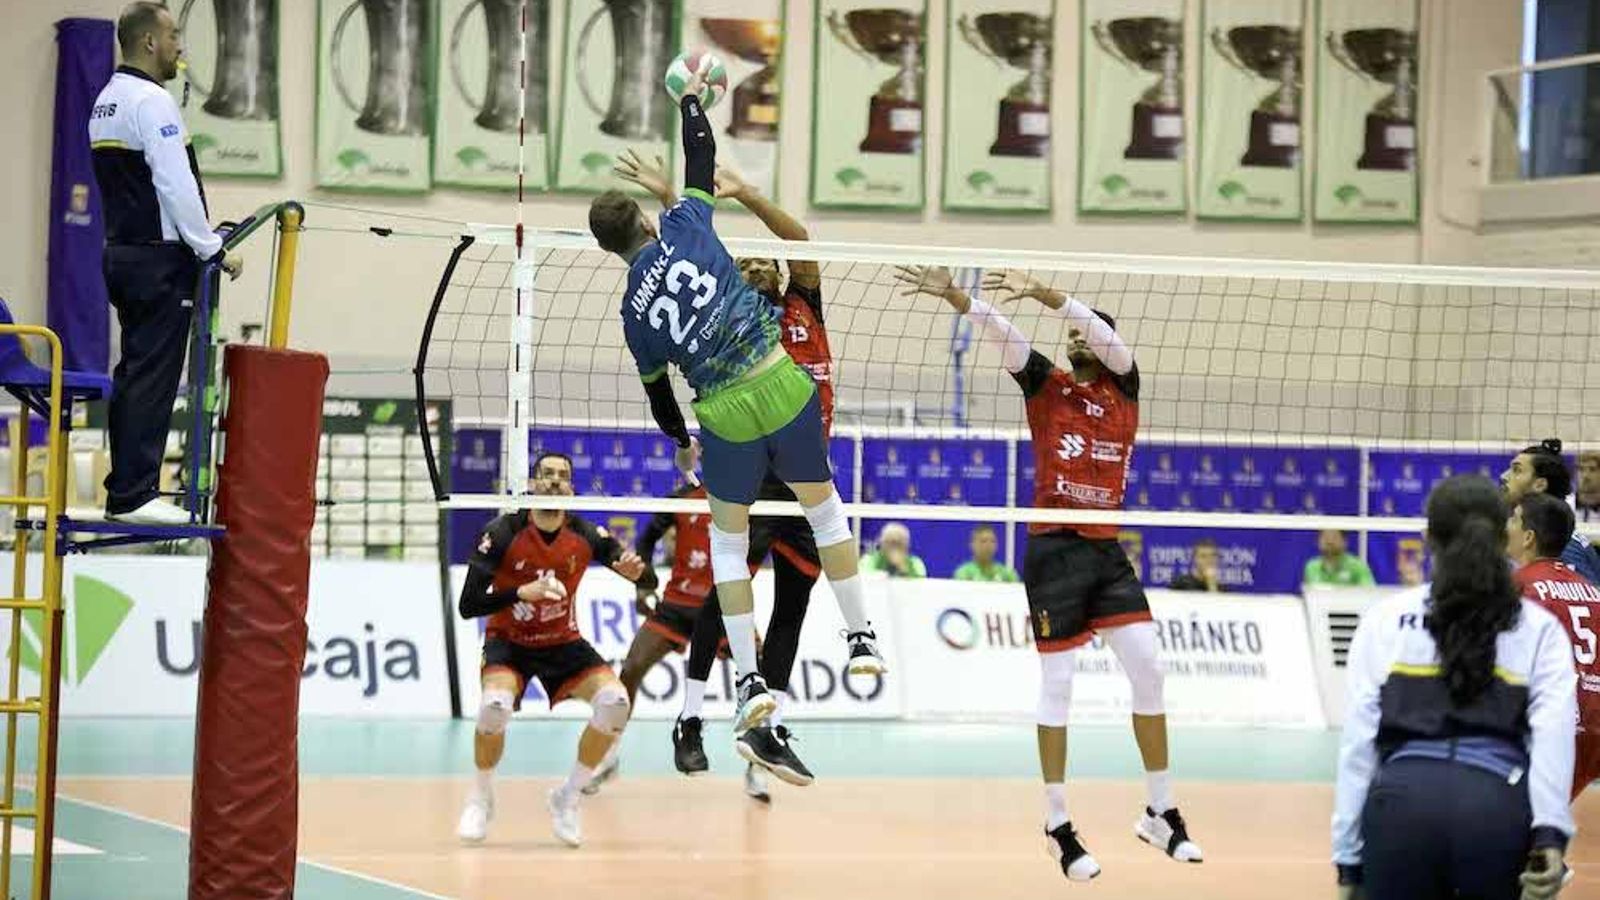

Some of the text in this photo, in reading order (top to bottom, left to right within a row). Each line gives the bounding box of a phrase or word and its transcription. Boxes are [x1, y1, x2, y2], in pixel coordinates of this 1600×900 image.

[648, 259, 718, 345] 23
[1533, 579, 1600, 603] PAQUILL
[155, 618, 421, 697] Ucaja
[1568, 605, 1597, 665] 5
